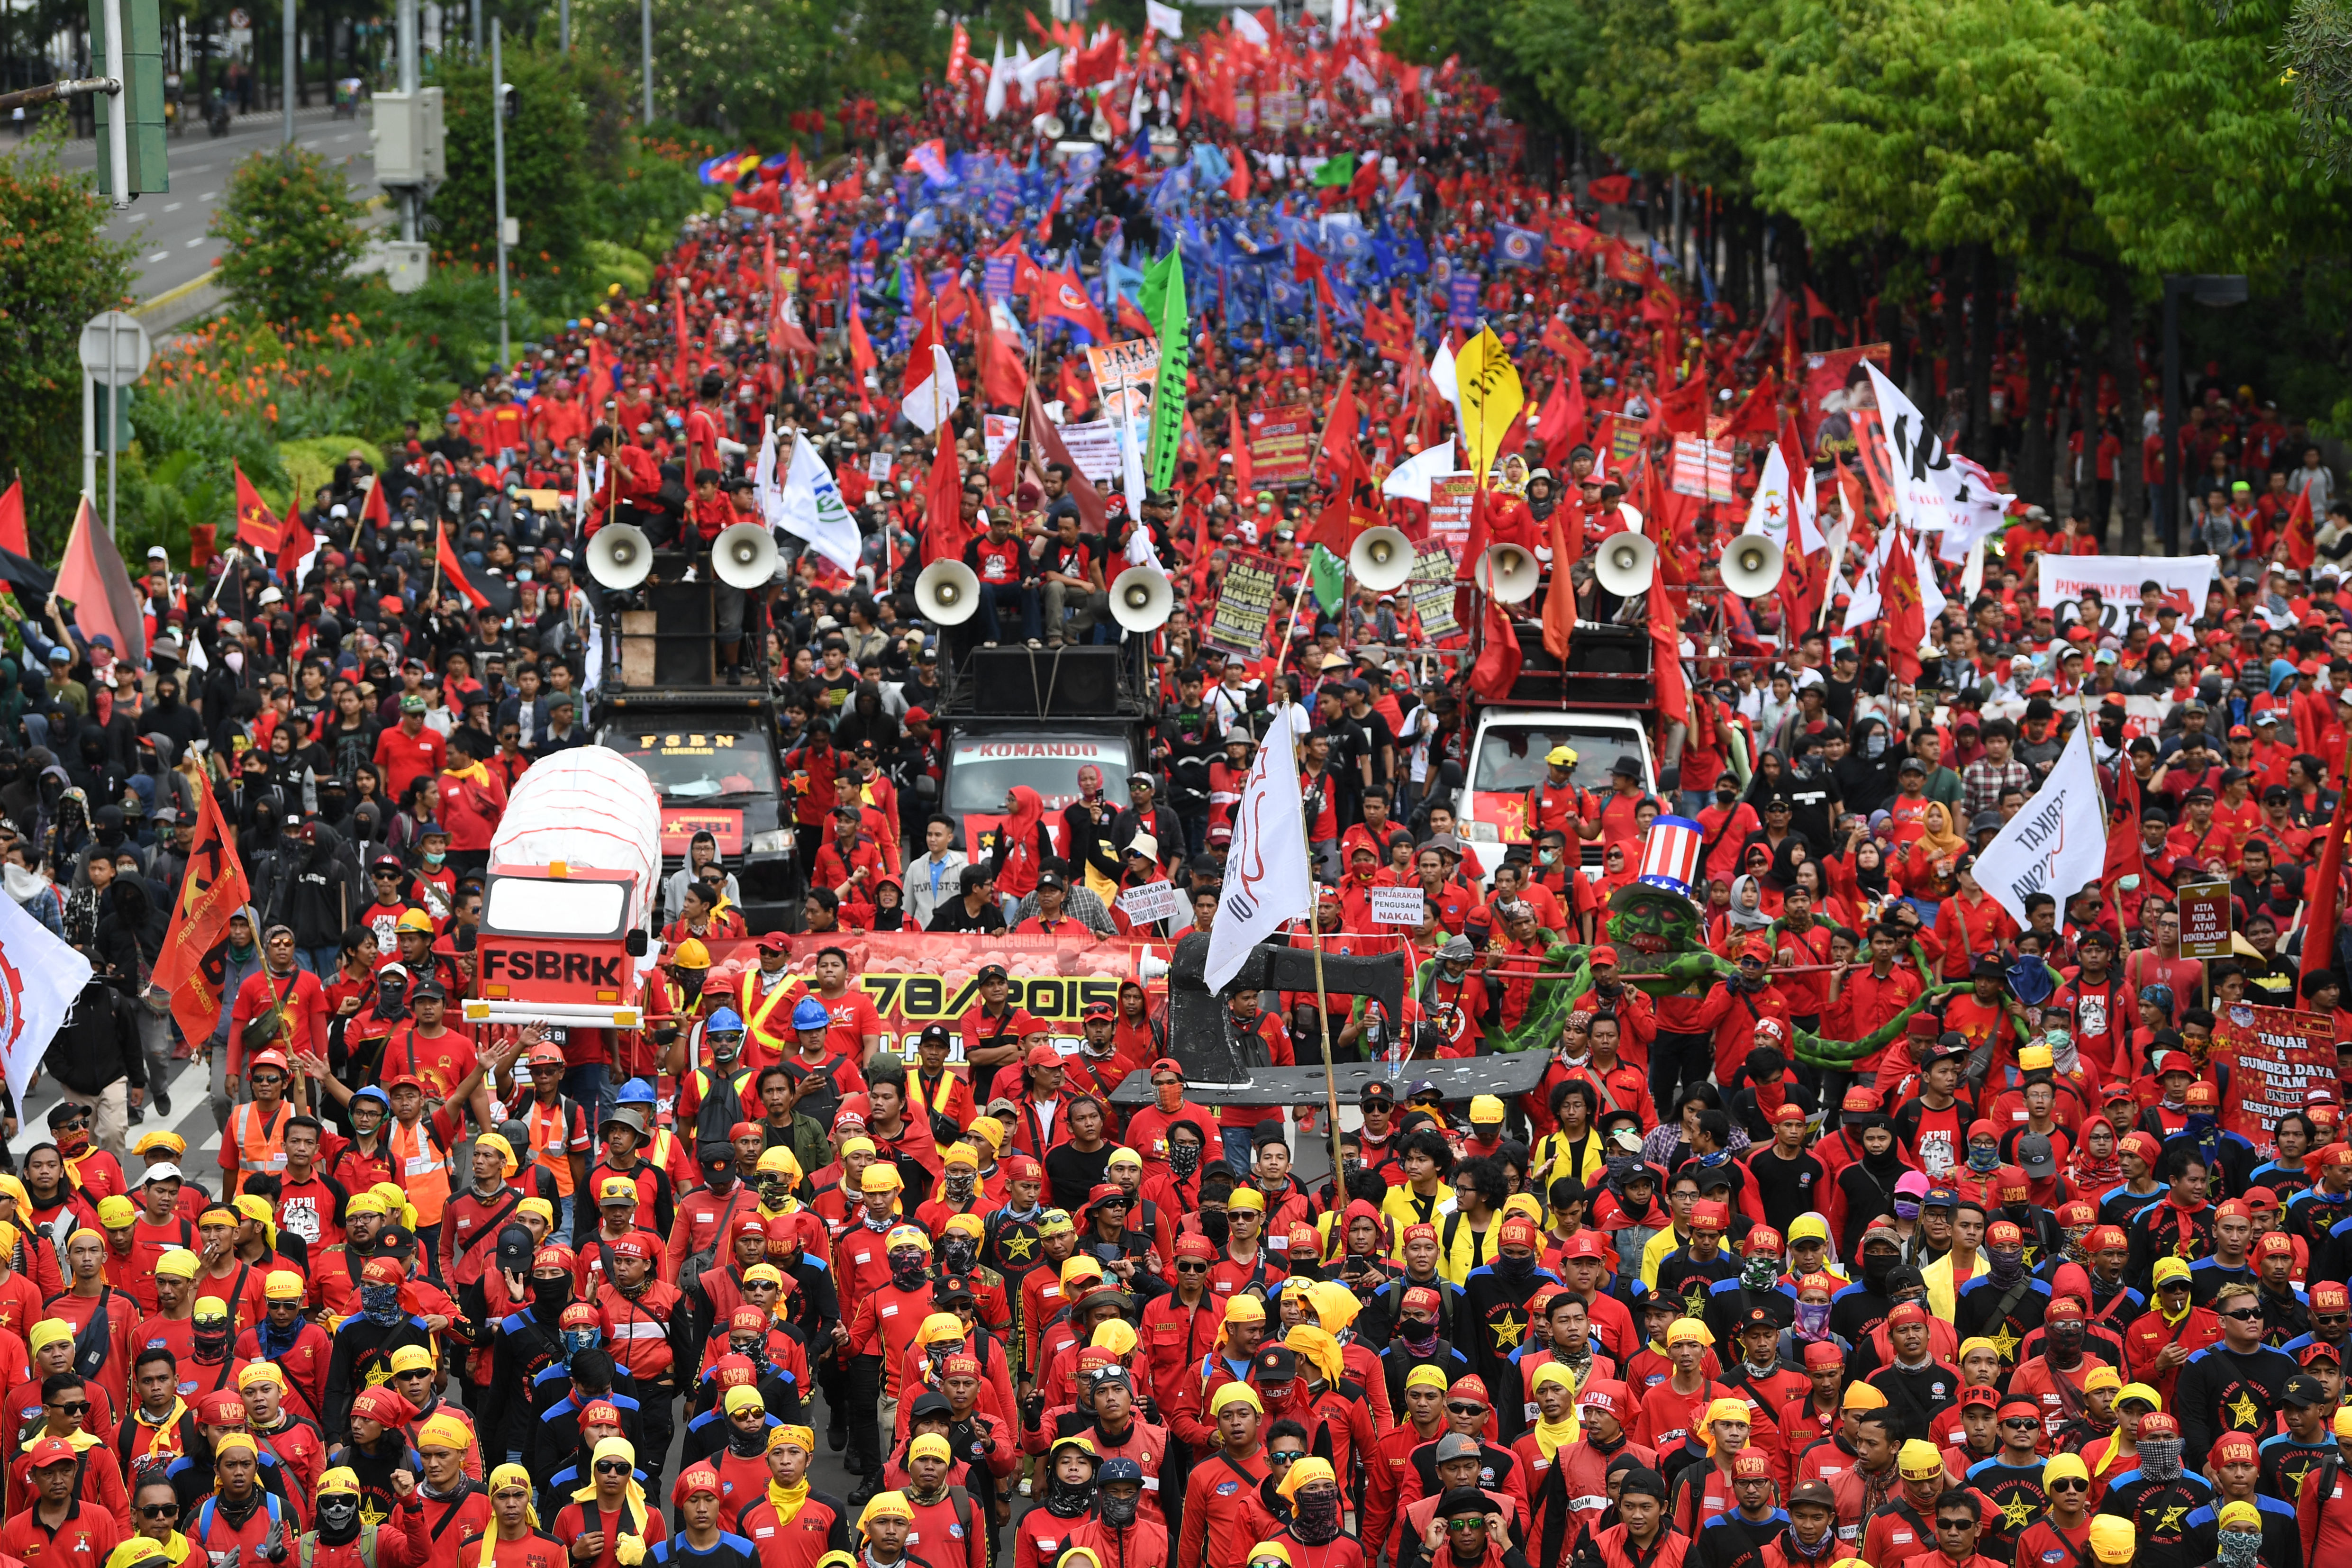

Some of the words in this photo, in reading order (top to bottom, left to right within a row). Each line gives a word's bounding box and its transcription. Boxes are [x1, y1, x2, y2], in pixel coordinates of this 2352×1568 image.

[1230, 562, 1276, 583] TOLAK
[1222, 586, 1272, 608] HAPUS
[1216, 610, 1263, 634] HAPUS
[661, 747, 714, 755] TANGERANG
[980, 743, 1098, 757] KOMANDO
[1128, 884, 1167, 899] BERIKAN
[1373, 891, 1422, 899] PENJARAKAN
[1375, 901, 1421, 909] PENGUSAHA
[2194, 903, 2214, 913] KITA
[1379, 912, 1417, 921] NAKAL
[2192, 913, 2217, 922] KERJA
[2194, 922, 2216, 932] ATAU
[2183, 931, 2227, 943] DIKERJAIN?
[483, 950, 622, 986] FSBRK
[2083, 995, 2105, 1004] KPBI
[2258, 1033, 2308, 1049] TANAH
[2277, 1049, 2286, 1060] &
[2239, 1056, 2292, 1076] SUMBER
[2294, 1064, 2336, 1079] DAYA
[2265, 1075, 2307, 1088] ALAM
[838, 1112, 863, 1122] KPBI
[1926, 1131, 1951, 1142] KPBI
[2003, 1186, 2026, 1194] BAPOR
[374, 1189, 392, 1202] KASBI
[2004, 1193, 2026, 1201] KPBI
[238, 1200, 255, 1213] KASBI
[289, 1196, 315, 1209] KPBI
[958, 1216, 973, 1225] KASBI
[1502, 1231, 1526, 1240] KPBI
[2317, 1297, 2344, 1307] KPBI
[1859, 1317, 1882, 1335] BARISAN
[722, 1368, 749, 1377] BAPOR
[950, 1364, 975, 1372] KPBI
[723, 1375, 749, 1384] KPBI
[1459, 1377, 1484, 1387] BAPOR
[2089, 1374, 2104, 1383] BARA
[1456, 1382, 1484, 1395] KPBI
[1964, 1389, 1996, 1403] FPBI
[431, 1428, 452, 1438] KASBI
[930, 1446, 945, 1455] KASBI
[2223, 1444, 2252, 1452] BAPOR
[134, 1455, 149, 1465] MAY
[2222, 1450, 2252, 1460] KPBI
[1736, 1458, 1764, 1467] BAPOR
[1736, 1463, 1764, 1475] KPBI
[686, 1471, 716, 1480] BAPOR
[686, 1477, 716, 1488] KPBI
[1990, 1480, 2018, 1498] BARISAN
[2020, 1480, 2045, 1501] MILITAN
[2139, 1485, 2165, 1503] BARISAN
[527, 1554, 546, 1562] BARA
